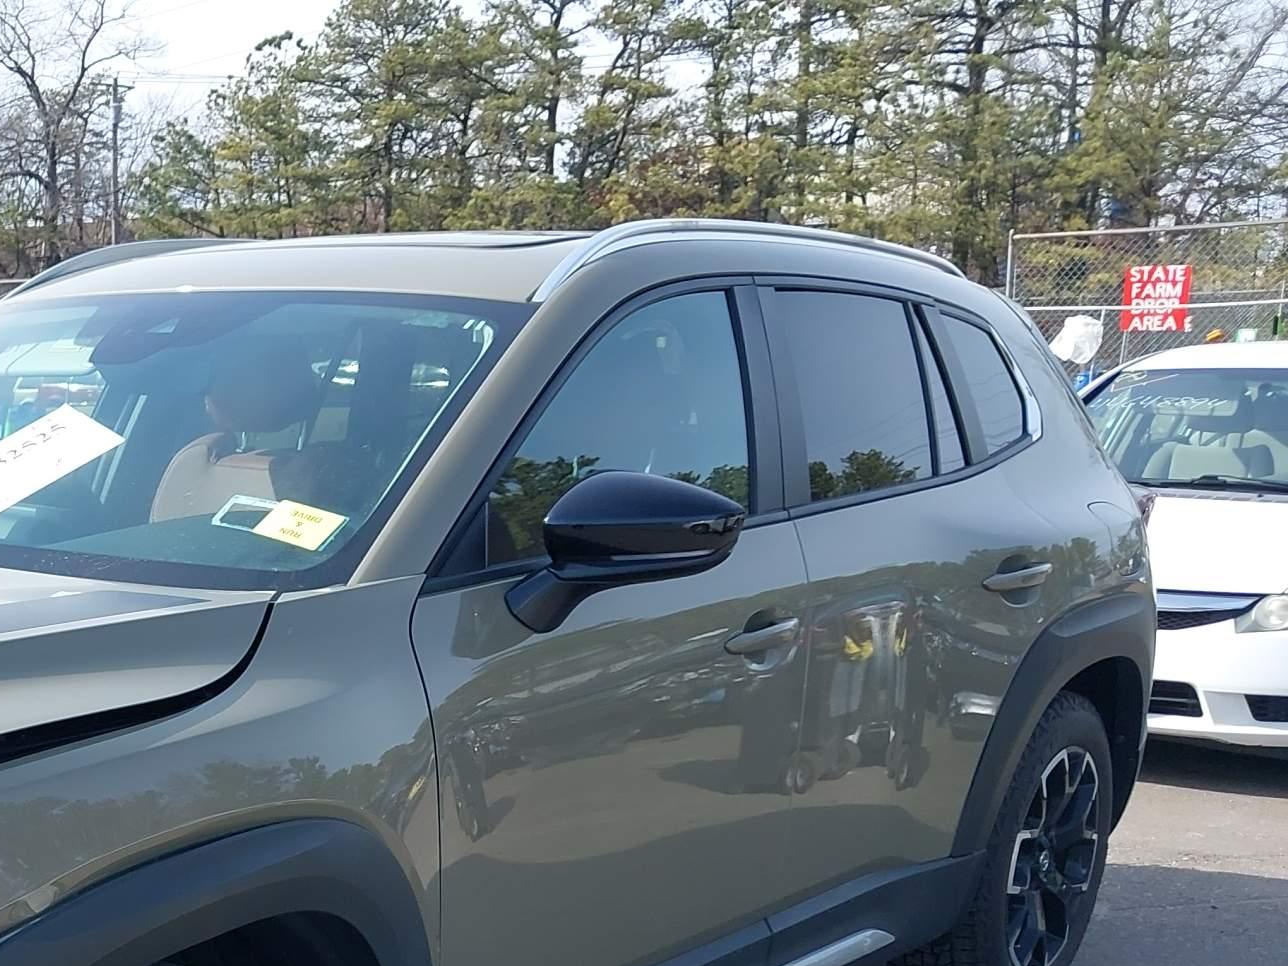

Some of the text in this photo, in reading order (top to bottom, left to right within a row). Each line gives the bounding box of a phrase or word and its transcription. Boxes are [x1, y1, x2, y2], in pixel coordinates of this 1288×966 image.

[1130, 265, 1187, 281] STATE
[1131, 282, 1182, 298] FARM
[1130, 298, 1180, 314] DROP
[1128, 315, 1176, 331] AREA
